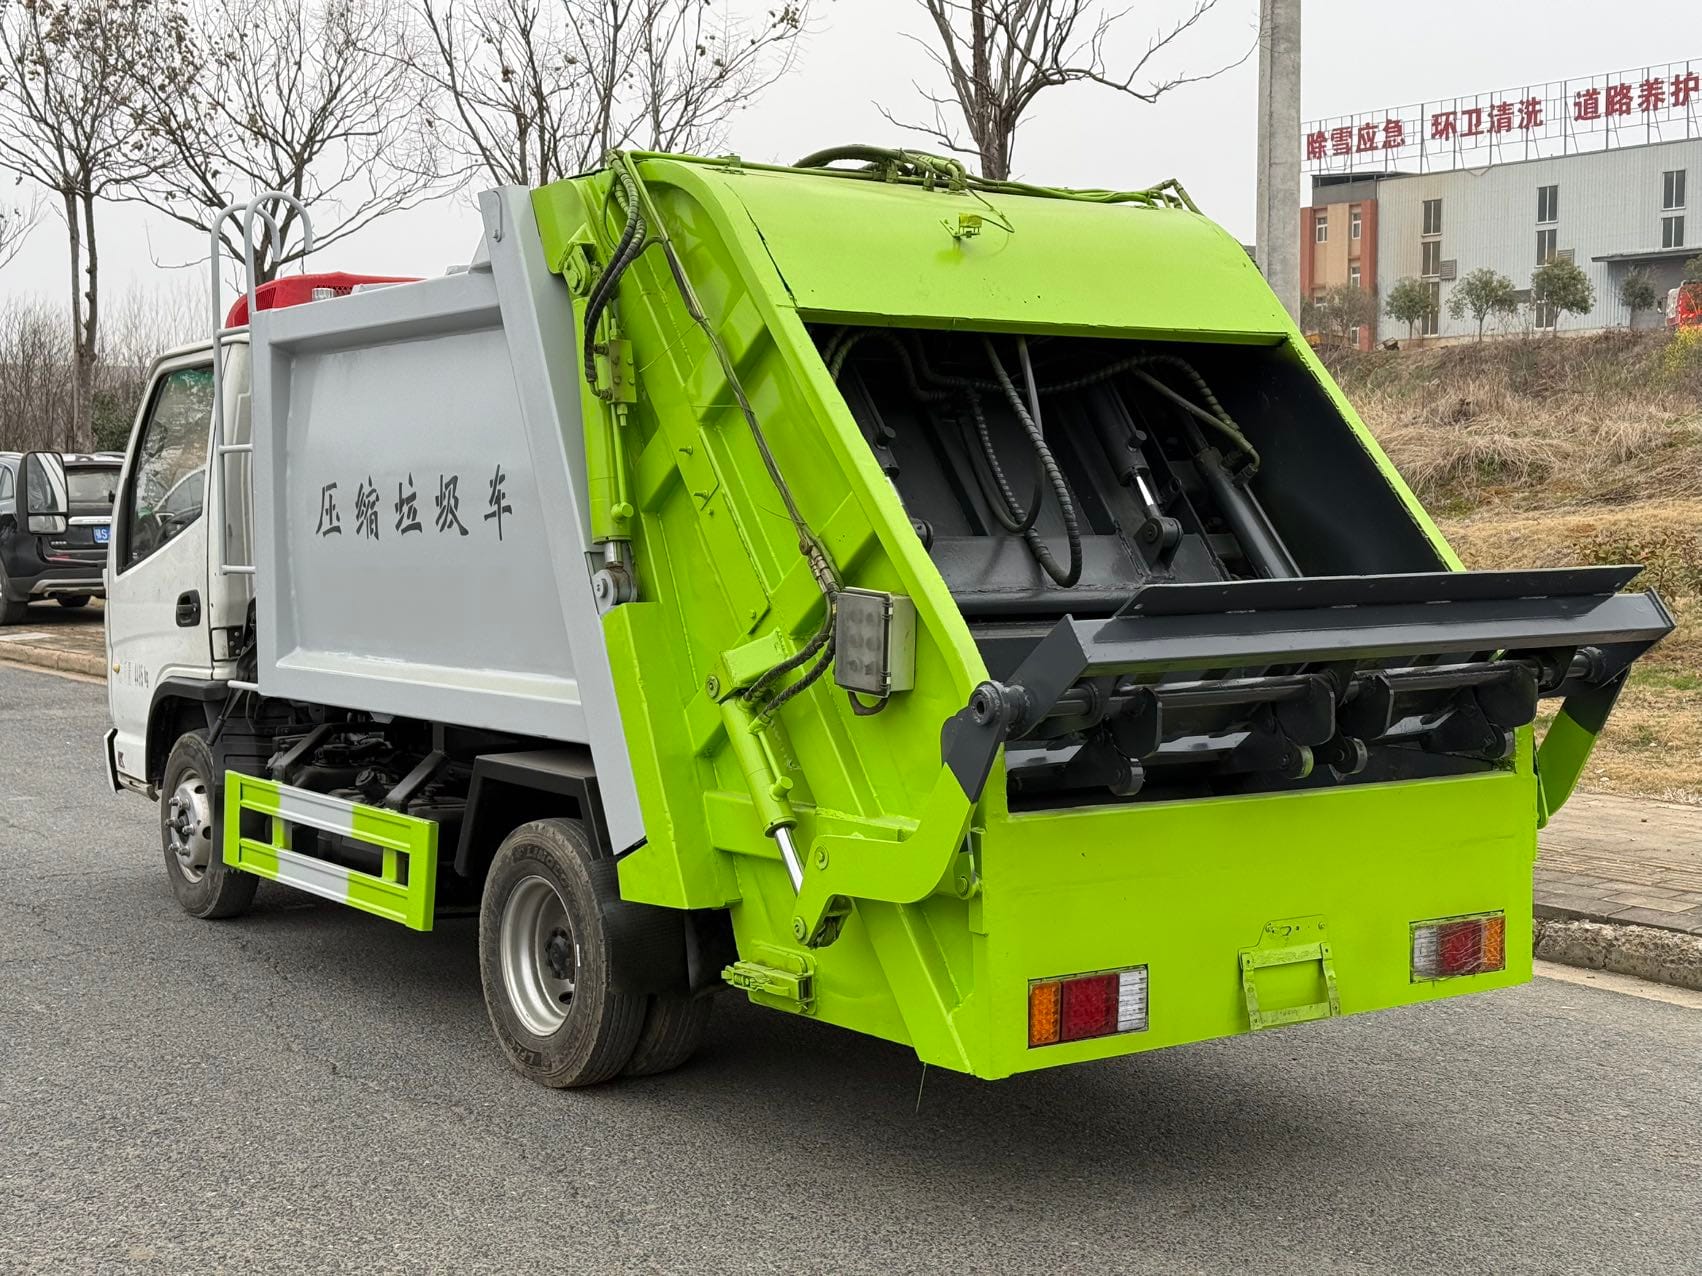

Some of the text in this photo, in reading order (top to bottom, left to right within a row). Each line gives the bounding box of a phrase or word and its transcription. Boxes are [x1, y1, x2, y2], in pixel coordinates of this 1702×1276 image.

[1306, 71, 1700, 160] 除雪应急 环卫清洗 道路养护
[315, 463, 513, 541] 压缩垃圾车
